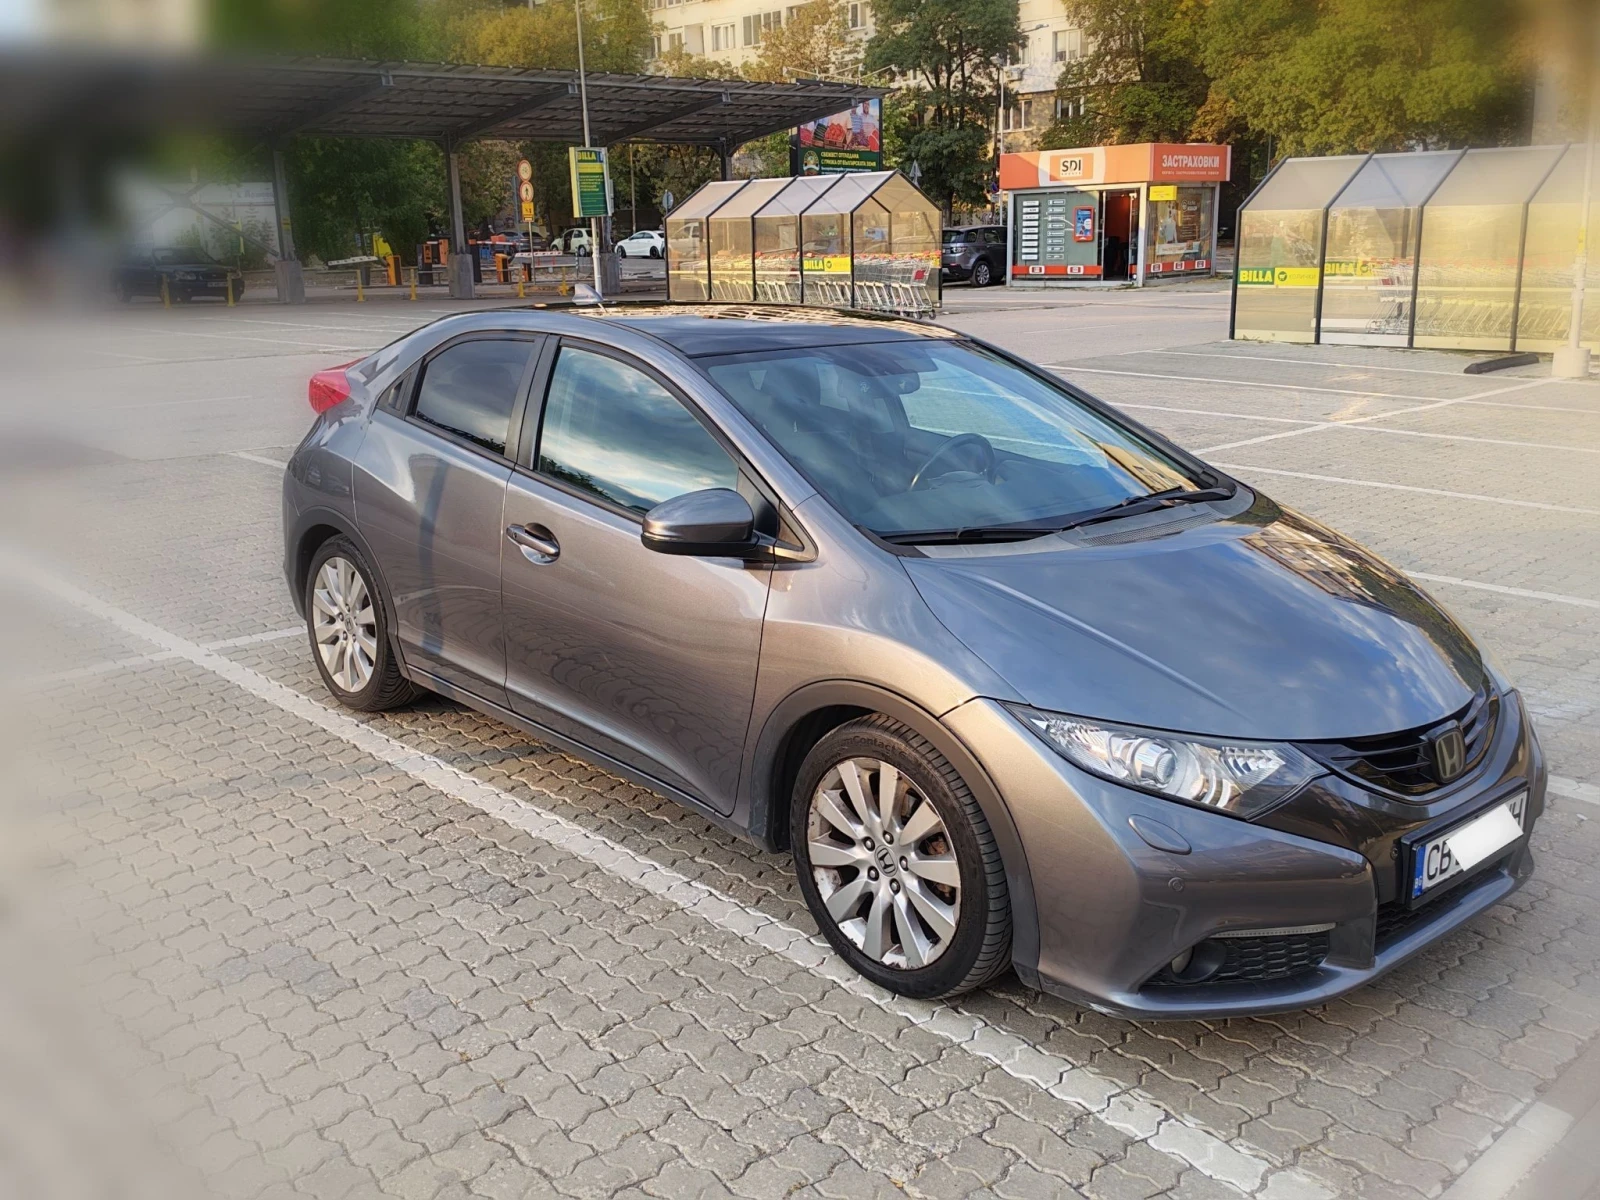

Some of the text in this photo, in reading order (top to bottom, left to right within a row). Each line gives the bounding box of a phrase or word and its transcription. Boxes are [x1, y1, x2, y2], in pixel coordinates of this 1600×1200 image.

[1061, 159, 1082, 172] SDI
[1161, 155, 1220, 168] ЗАСТРАХОВКИ
[803, 259, 825, 270] BILLA
[1239, 270, 1273, 283] BILLA
